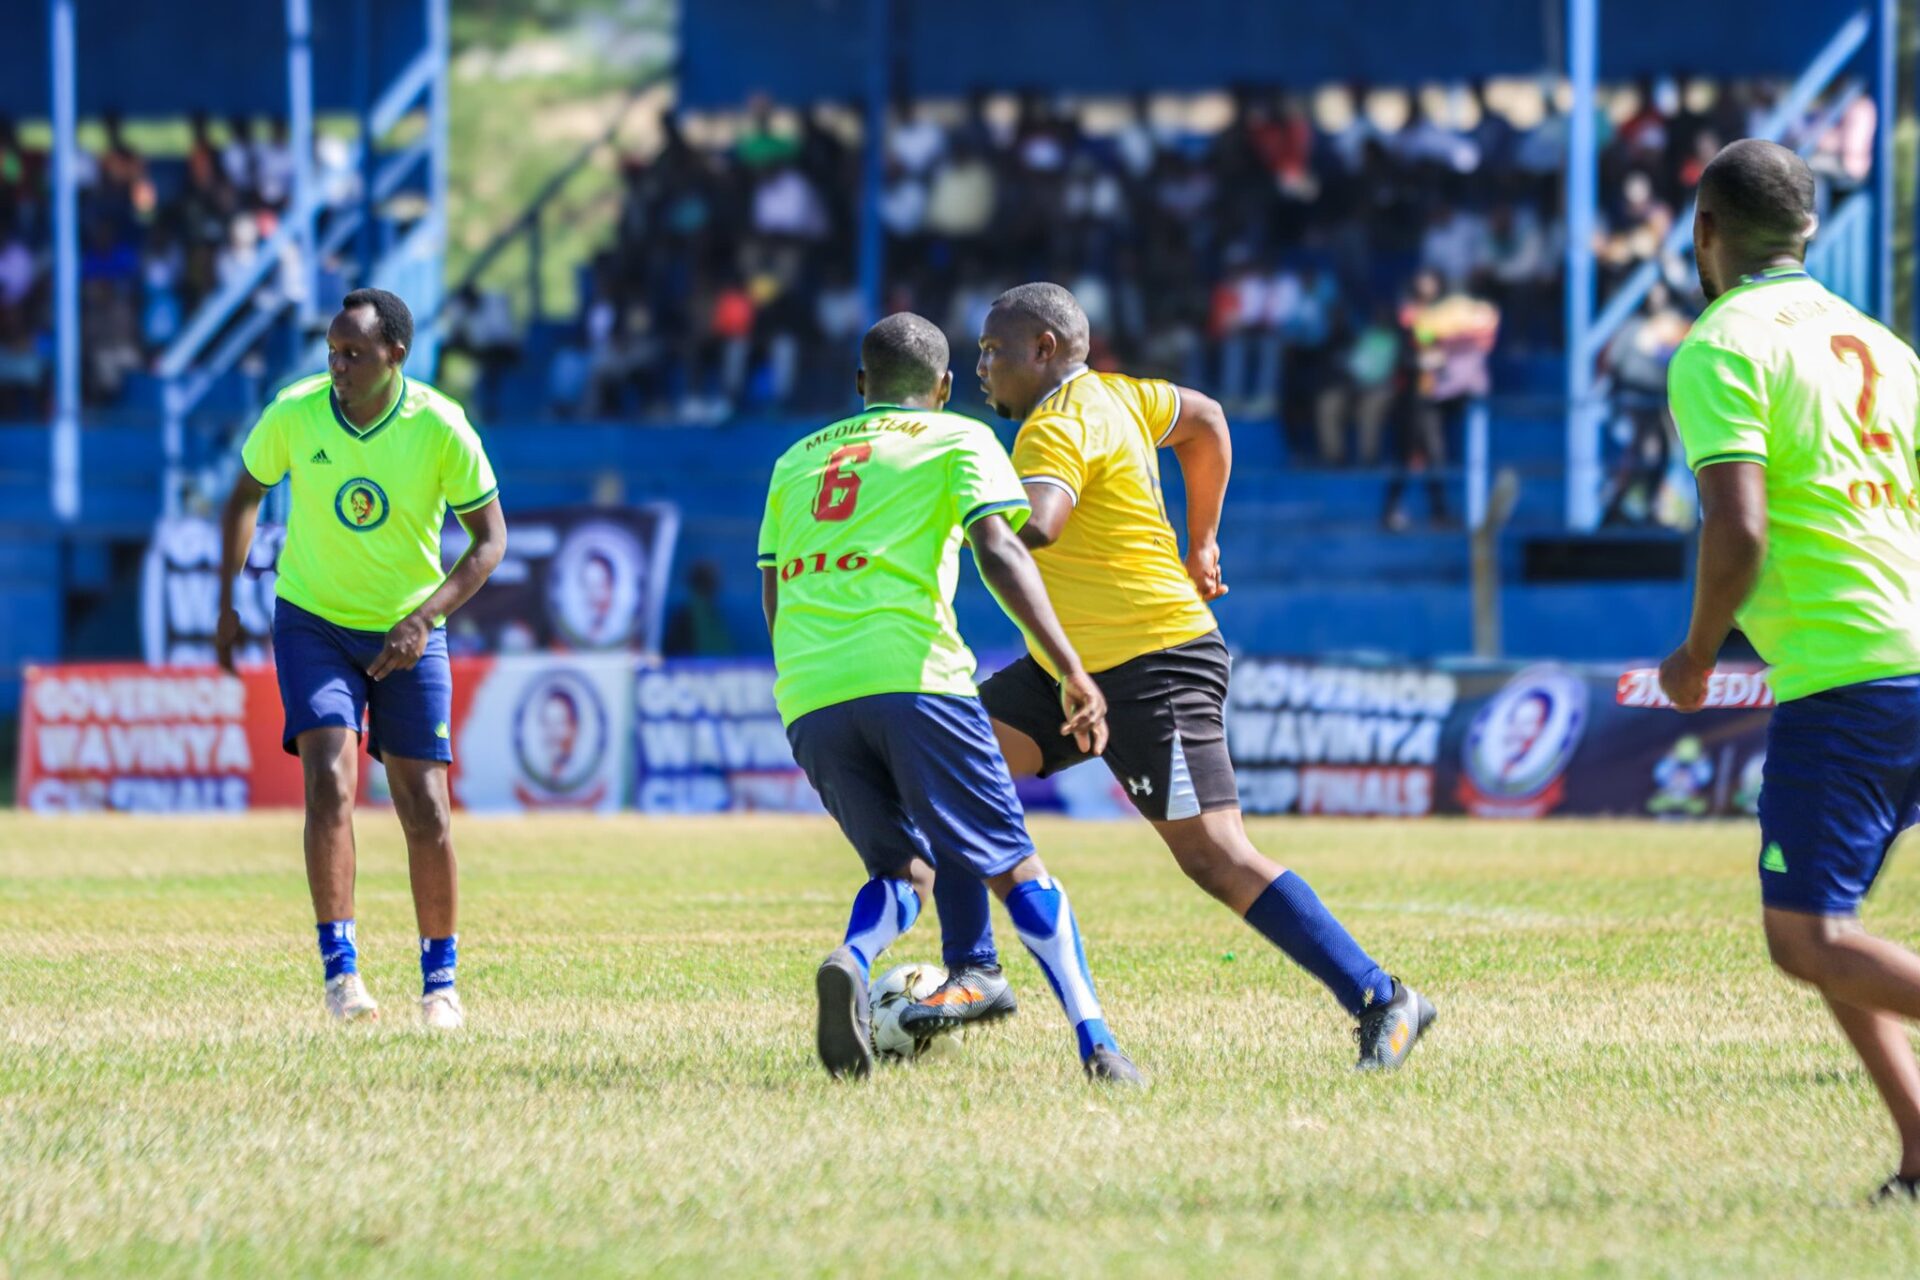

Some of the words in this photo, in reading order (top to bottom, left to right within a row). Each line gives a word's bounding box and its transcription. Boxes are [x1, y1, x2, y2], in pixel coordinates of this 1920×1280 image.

[1829, 334, 1893, 452] 2
[805, 421, 869, 451] MEDIA
[876, 416, 929, 439] TEAM
[811, 440, 873, 523] 6
[780, 551, 869, 582] 016
[34, 675, 246, 722] GOVERNOR
[1232, 661, 1457, 718] GOVERNOR
[37, 722, 252, 774] WAVINYA
[1230, 709, 1441, 766] WAVINYA
[1300, 768, 1432, 817] FINALS
